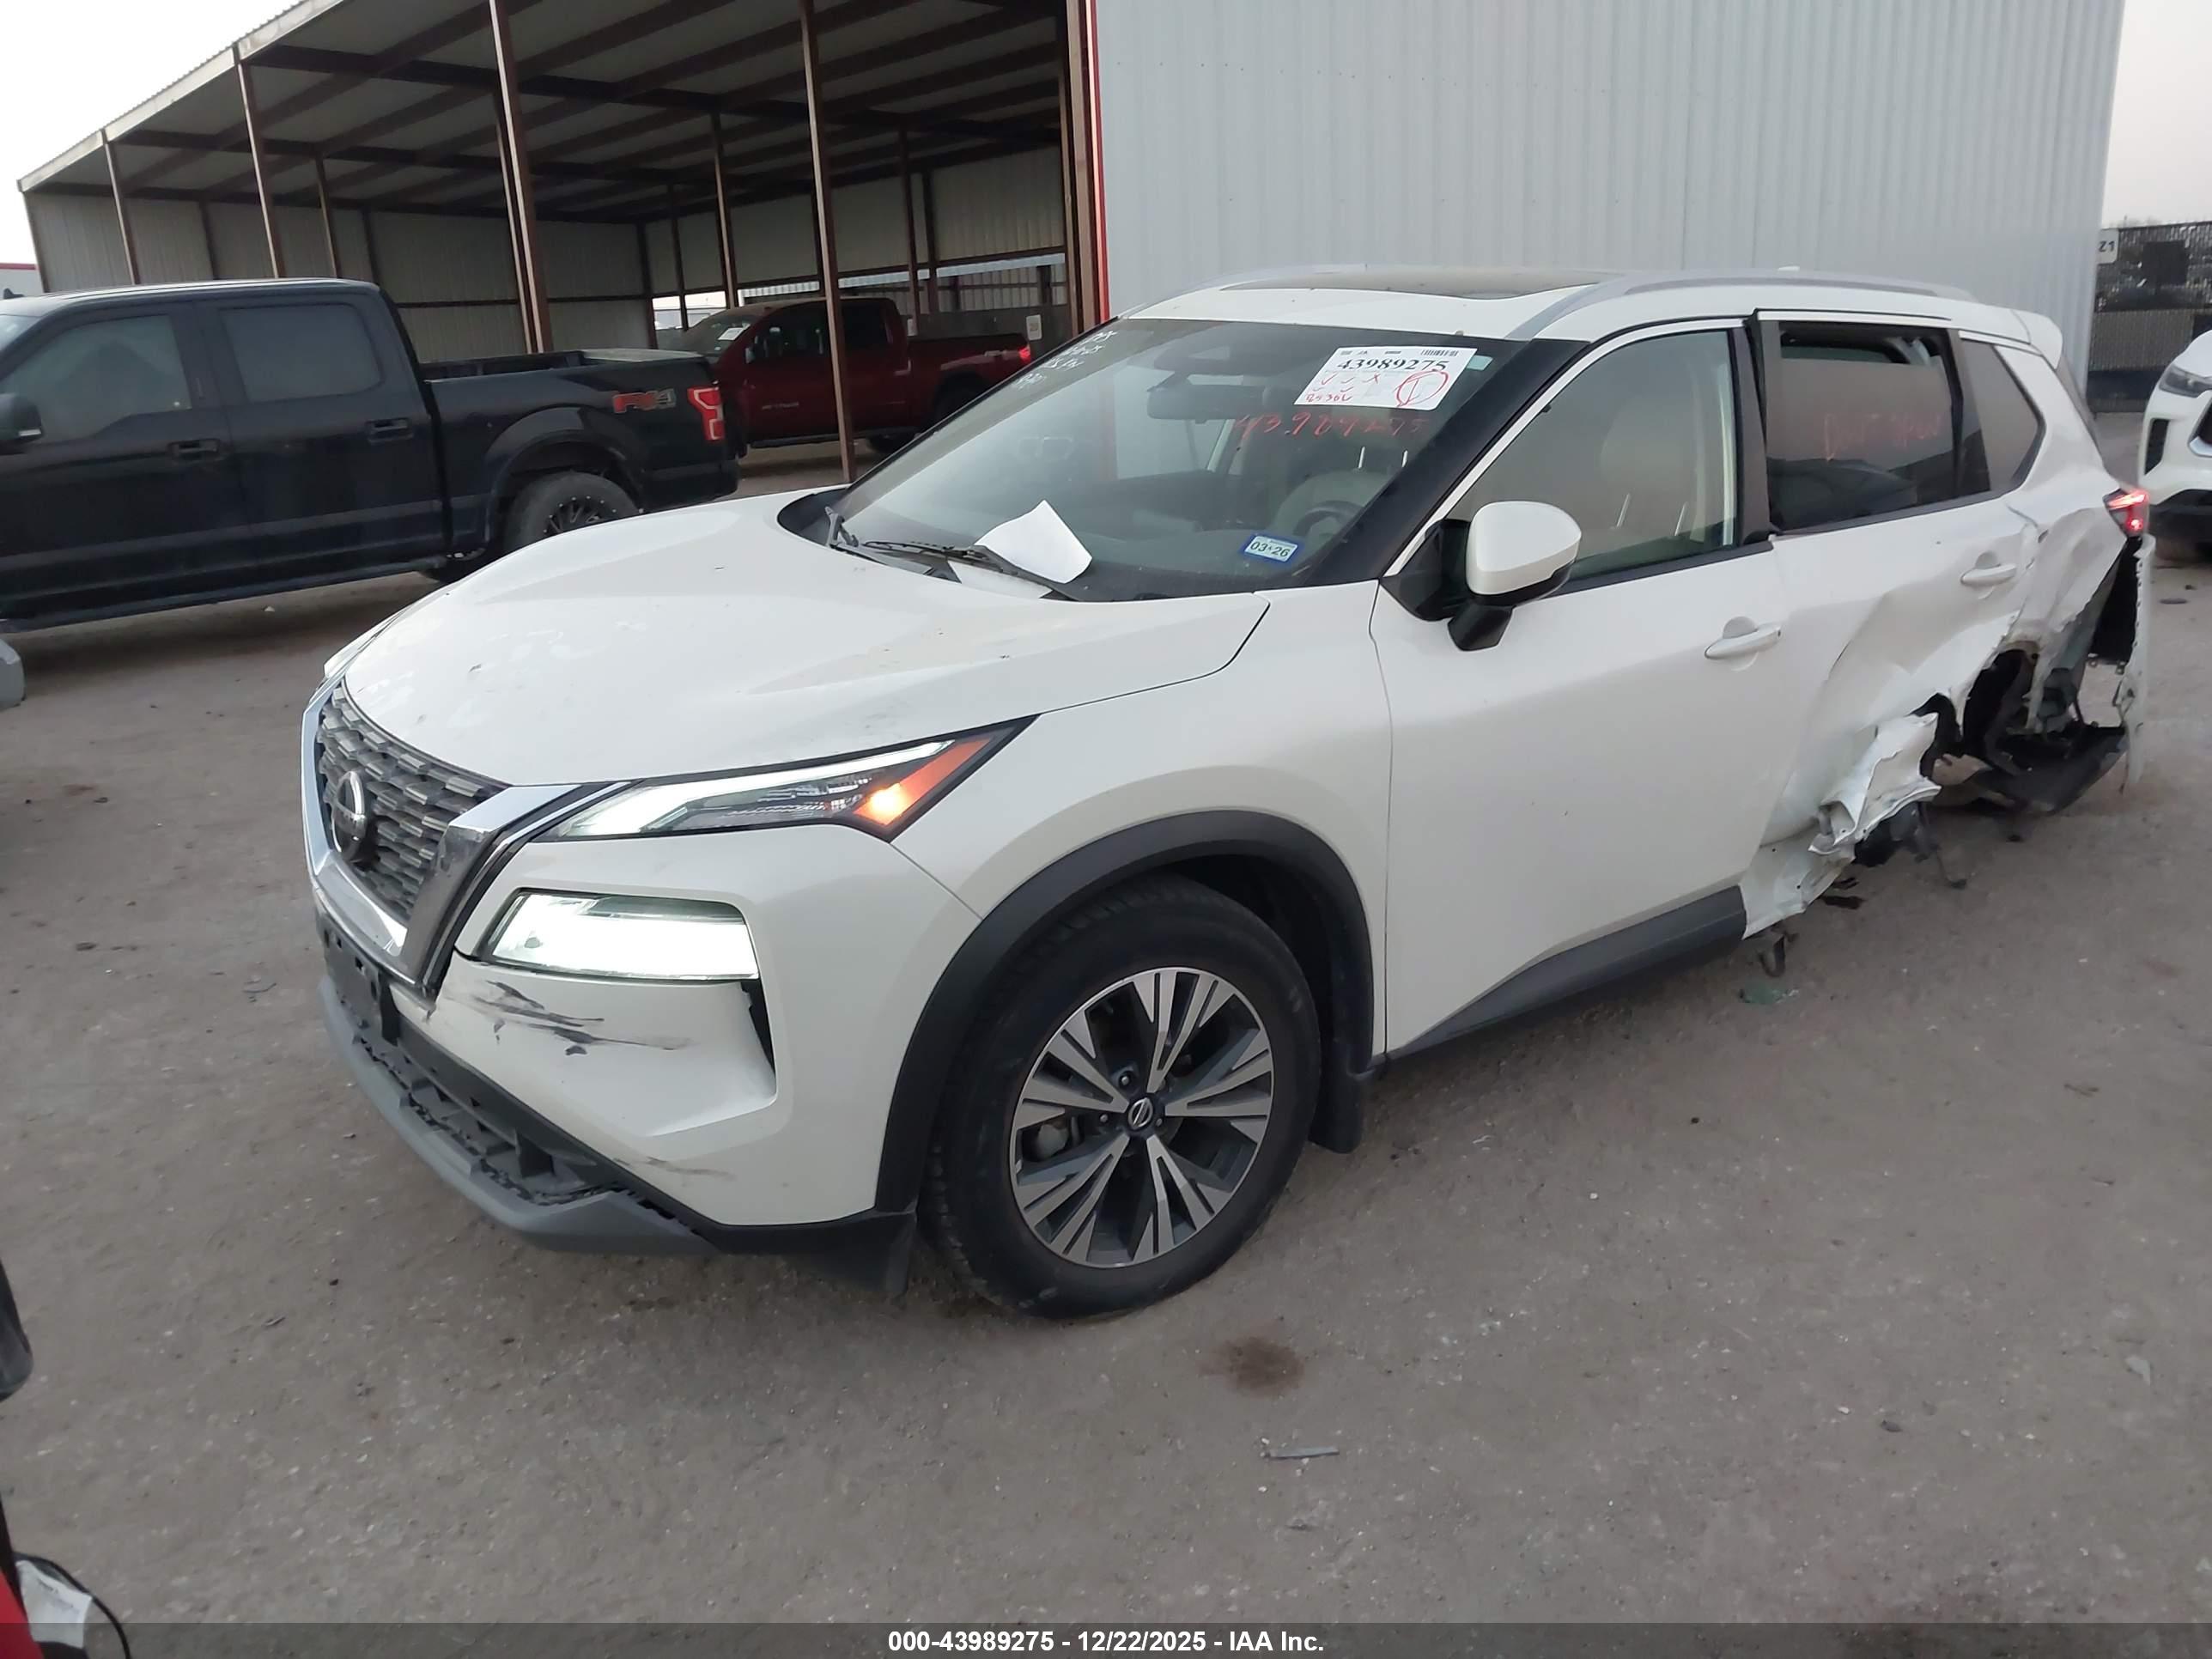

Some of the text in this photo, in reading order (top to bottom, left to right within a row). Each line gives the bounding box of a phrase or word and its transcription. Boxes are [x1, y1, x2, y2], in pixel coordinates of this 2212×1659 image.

[1337, 358, 1450, 372] 43989275
[1250, 541, 1291, 557] 03 26
